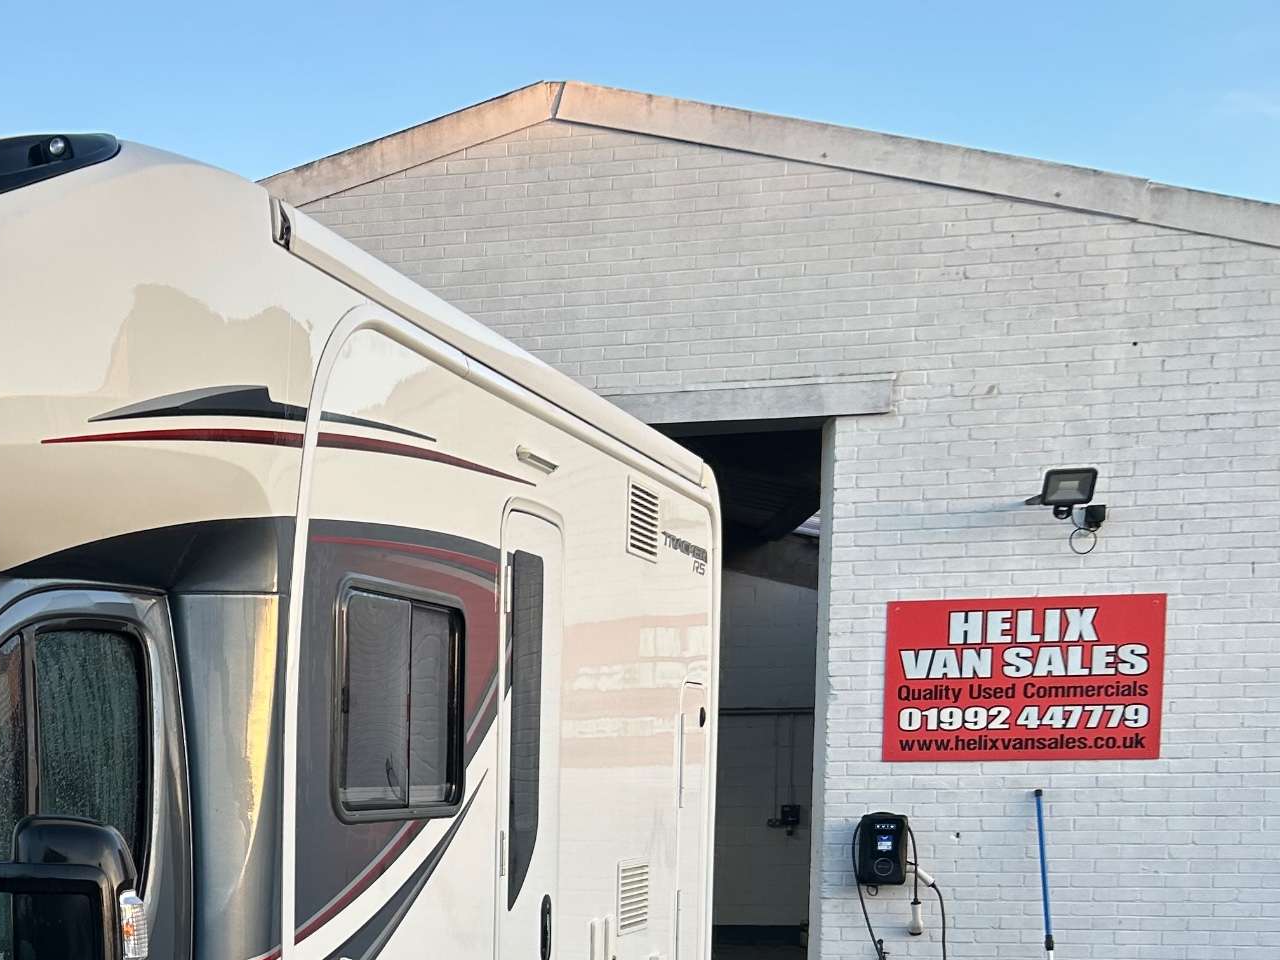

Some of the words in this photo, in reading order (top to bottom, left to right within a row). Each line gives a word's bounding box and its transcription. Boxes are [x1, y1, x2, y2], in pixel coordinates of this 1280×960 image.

[692, 560, 706, 576] RS
[948, 607, 1100, 646] HELIX
[899, 647, 993, 680] VAN
[1001, 643, 1150, 678] SALES
[897, 684, 962, 703] Quality
[969, 683, 1016, 700] Used
[1023, 681, 1149, 698] Commercials
[897, 705, 1010, 731] 01992
[1016, 703, 1150, 731] 447779
[899, 732, 1146, 752] www.helixvansales.co.uk
